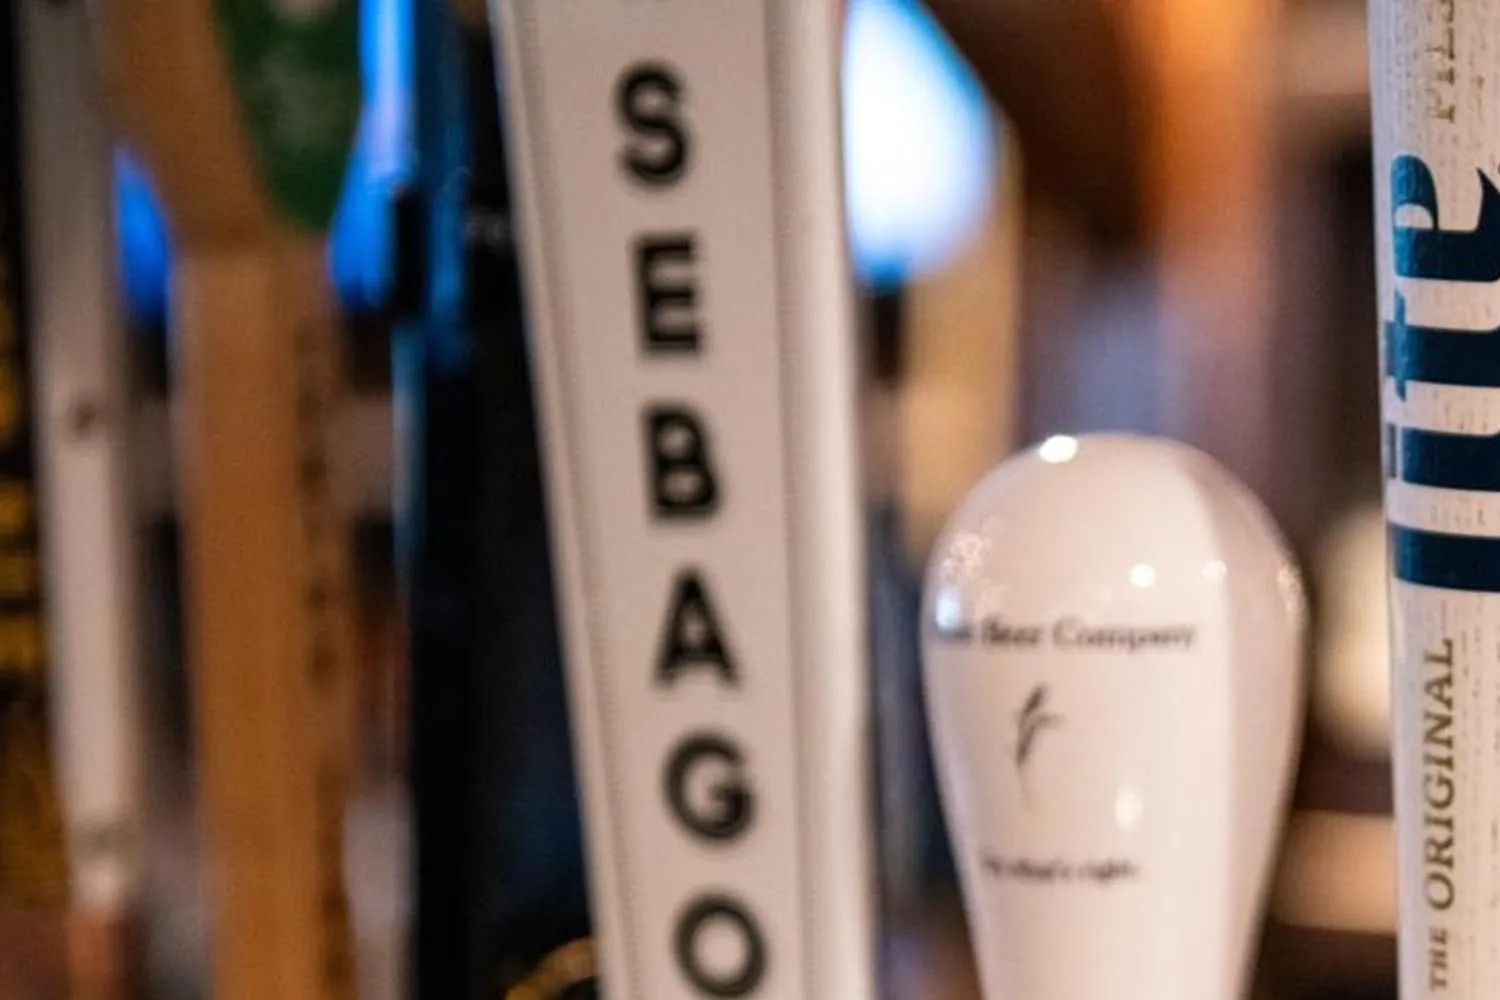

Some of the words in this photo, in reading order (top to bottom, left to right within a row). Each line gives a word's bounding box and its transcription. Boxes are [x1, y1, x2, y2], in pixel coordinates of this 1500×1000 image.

[1052, 613, 1199, 656] Company
[1423, 636, 1455, 911] ORIGINAL
[1428, 925, 1450, 993] THE
